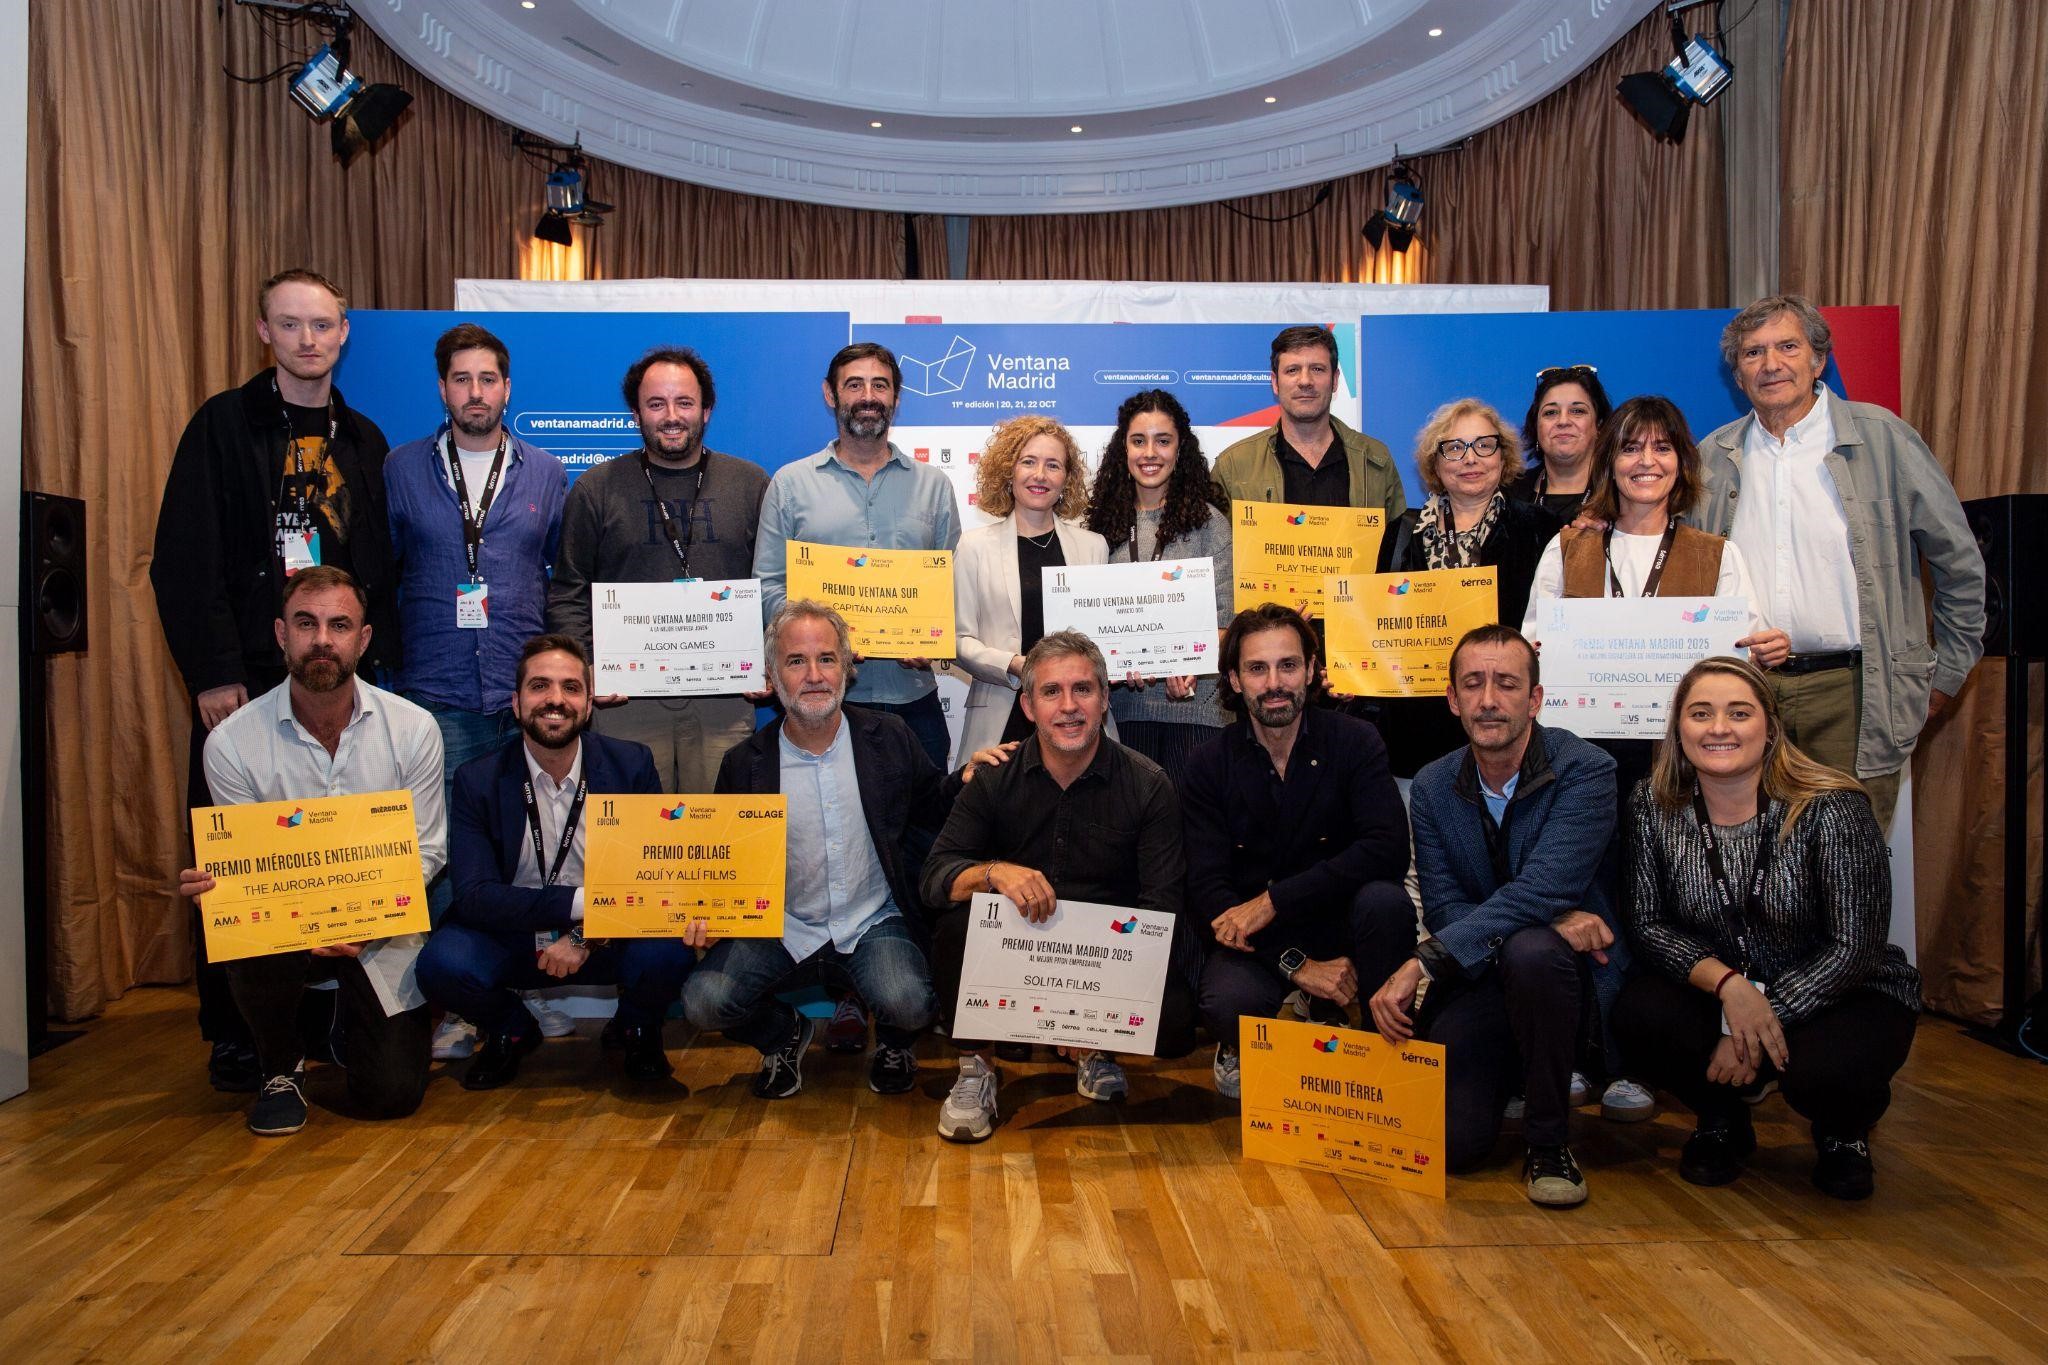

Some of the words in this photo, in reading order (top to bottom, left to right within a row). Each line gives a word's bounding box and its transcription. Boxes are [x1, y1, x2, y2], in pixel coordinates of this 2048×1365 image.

[988, 354, 1070, 371] Ventana
[988, 373, 1056, 389] Madrid
[965, 400, 994, 408] edición
[1001, 401, 1013, 409] 20,
[1015, 401, 1026, 409] 21,
[1244, 506, 1253, 519] 11
[1367, 516, 1379, 524] VS
[800, 546, 809, 559] 11
[1265, 543, 1294, 556] PREMIO
[1298, 545, 1333, 558] VENTANA
[1337, 547, 1352, 558] SUR
[933, 557, 946, 565] VS
[1277, 564, 1298, 572] PLAY
[1300, 564, 1317, 573] THE
[1320, 566, 1340, 574] UNIT
[1056, 573, 1066, 586] 11
[822, 583, 855, 596] PREMIO
[859, 586, 897, 598] VENTANA
[901, 588, 918, 598] SUR
[1338, 580, 1348, 595] 11
[606, 590, 616, 602] 11
[1074, 598, 1100, 608] PREMIO
[1103, 596, 1134, 607] VENTANA
[1137, 595, 1165, 605] MADRID
[1168, 593, 1185, 603] 2025
[1334, 595, 1353, 603] EDICIÓN
[833, 602, 873, 613] CAPITÁN
[875, 604, 908, 614] ARAÑA
[624, 615, 649, 625] PREMIO
[653, 614, 683, 624] VENTANA
[686, 613, 713, 623] MADRID
[716, 612, 733, 622] 2025
[1378, 616, 1412, 630] PREMIO
[1416, 614, 1447, 629] TÉRREA
[1098, 623, 1164, 634] MALVALANDA
[644, 643, 677, 651] ALGON
[680, 641, 715, 650] GAMES
[1372, 638, 1422, 649] CENTURIA
[1425, 637, 1453, 646] FILMS
[1608, 639, 1645, 650] VENTANA
[1649, 639, 1684, 650] MADRID
[1687, 638, 1710, 649] 2025
[1587, 672, 1651, 683] TORNASOL
[1545, 699, 1568, 707] AMA
[309, 809, 338, 818] Ventana
[603, 800, 614, 817] 11
[738, 810, 784, 819] CØLLAGE
[210, 812, 224, 831] 11
[309, 816, 334, 824] Madrid
[597, 817, 619, 826] EDICIÓN
[207, 831, 232, 842] EDICIÓN
[643, 845, 683, 860] PREMIO
[688, 844, 730, 860] CØLLAGE
[205, 859, 250, 878] PREMIO
[256, 850, 321, 873] MIÉRCOLES
[325, 840, 413, 865] ENTERTAINMENT
[636, 868, 664, 881] AQUÍ
[666, 870, 675, 880] Y
[677, 868, 700, 880] ALLÍ
[704, 870, 736, 880] FILMS
[243, 883, 269, 896] THE
[272, 878, 325, 893] AURORA
[328, 869, 383, 886] PROJECT
[593, 897, 617, 906] AMA
[987, 902, 999, 920] 11
[214, 915, 241, 927] AMA
[980, 919, 1002, 929] EDICIÓN
[1140, 929, 1163, 938] Madrid
[1141, 923, 1169, 932] Ventana
[1002, 938, 1033, 952] PREMIO
[1037, 941, 1073, 955] VENTANA
[1076, 944, 1109, 959] MADRID
[1112, 949, 1133, 962] 2025
[1024, 975, 1063, 988] SOLITA
[1066, 979, 1101, 992] FILMS
[966, 998, 989, 1008] AMA
[1045, 1020, 1055, 1028] VS
[1256, 1024, 1267, 1041] 11
[1251, 1041, 1273, 1050] EDICIÓN
[1343, 1042, 1370, 1051] Ventana
[1343, 1049, 1366, 1058] Madrid
[1401, 1052, 1439, 1067] térrea
[1301, 1075, 1341, 1096] PREMIO
[1345, 1080, 1383, 1103] TÉRREA
[1283, 1098, 1322, 1113] SALON
[1325, 1104, 1364, 1121] INDIEN
[1367, 1112, 1402, 1129] FILMS
[1250, 1120, 1273, 1130] AMA
